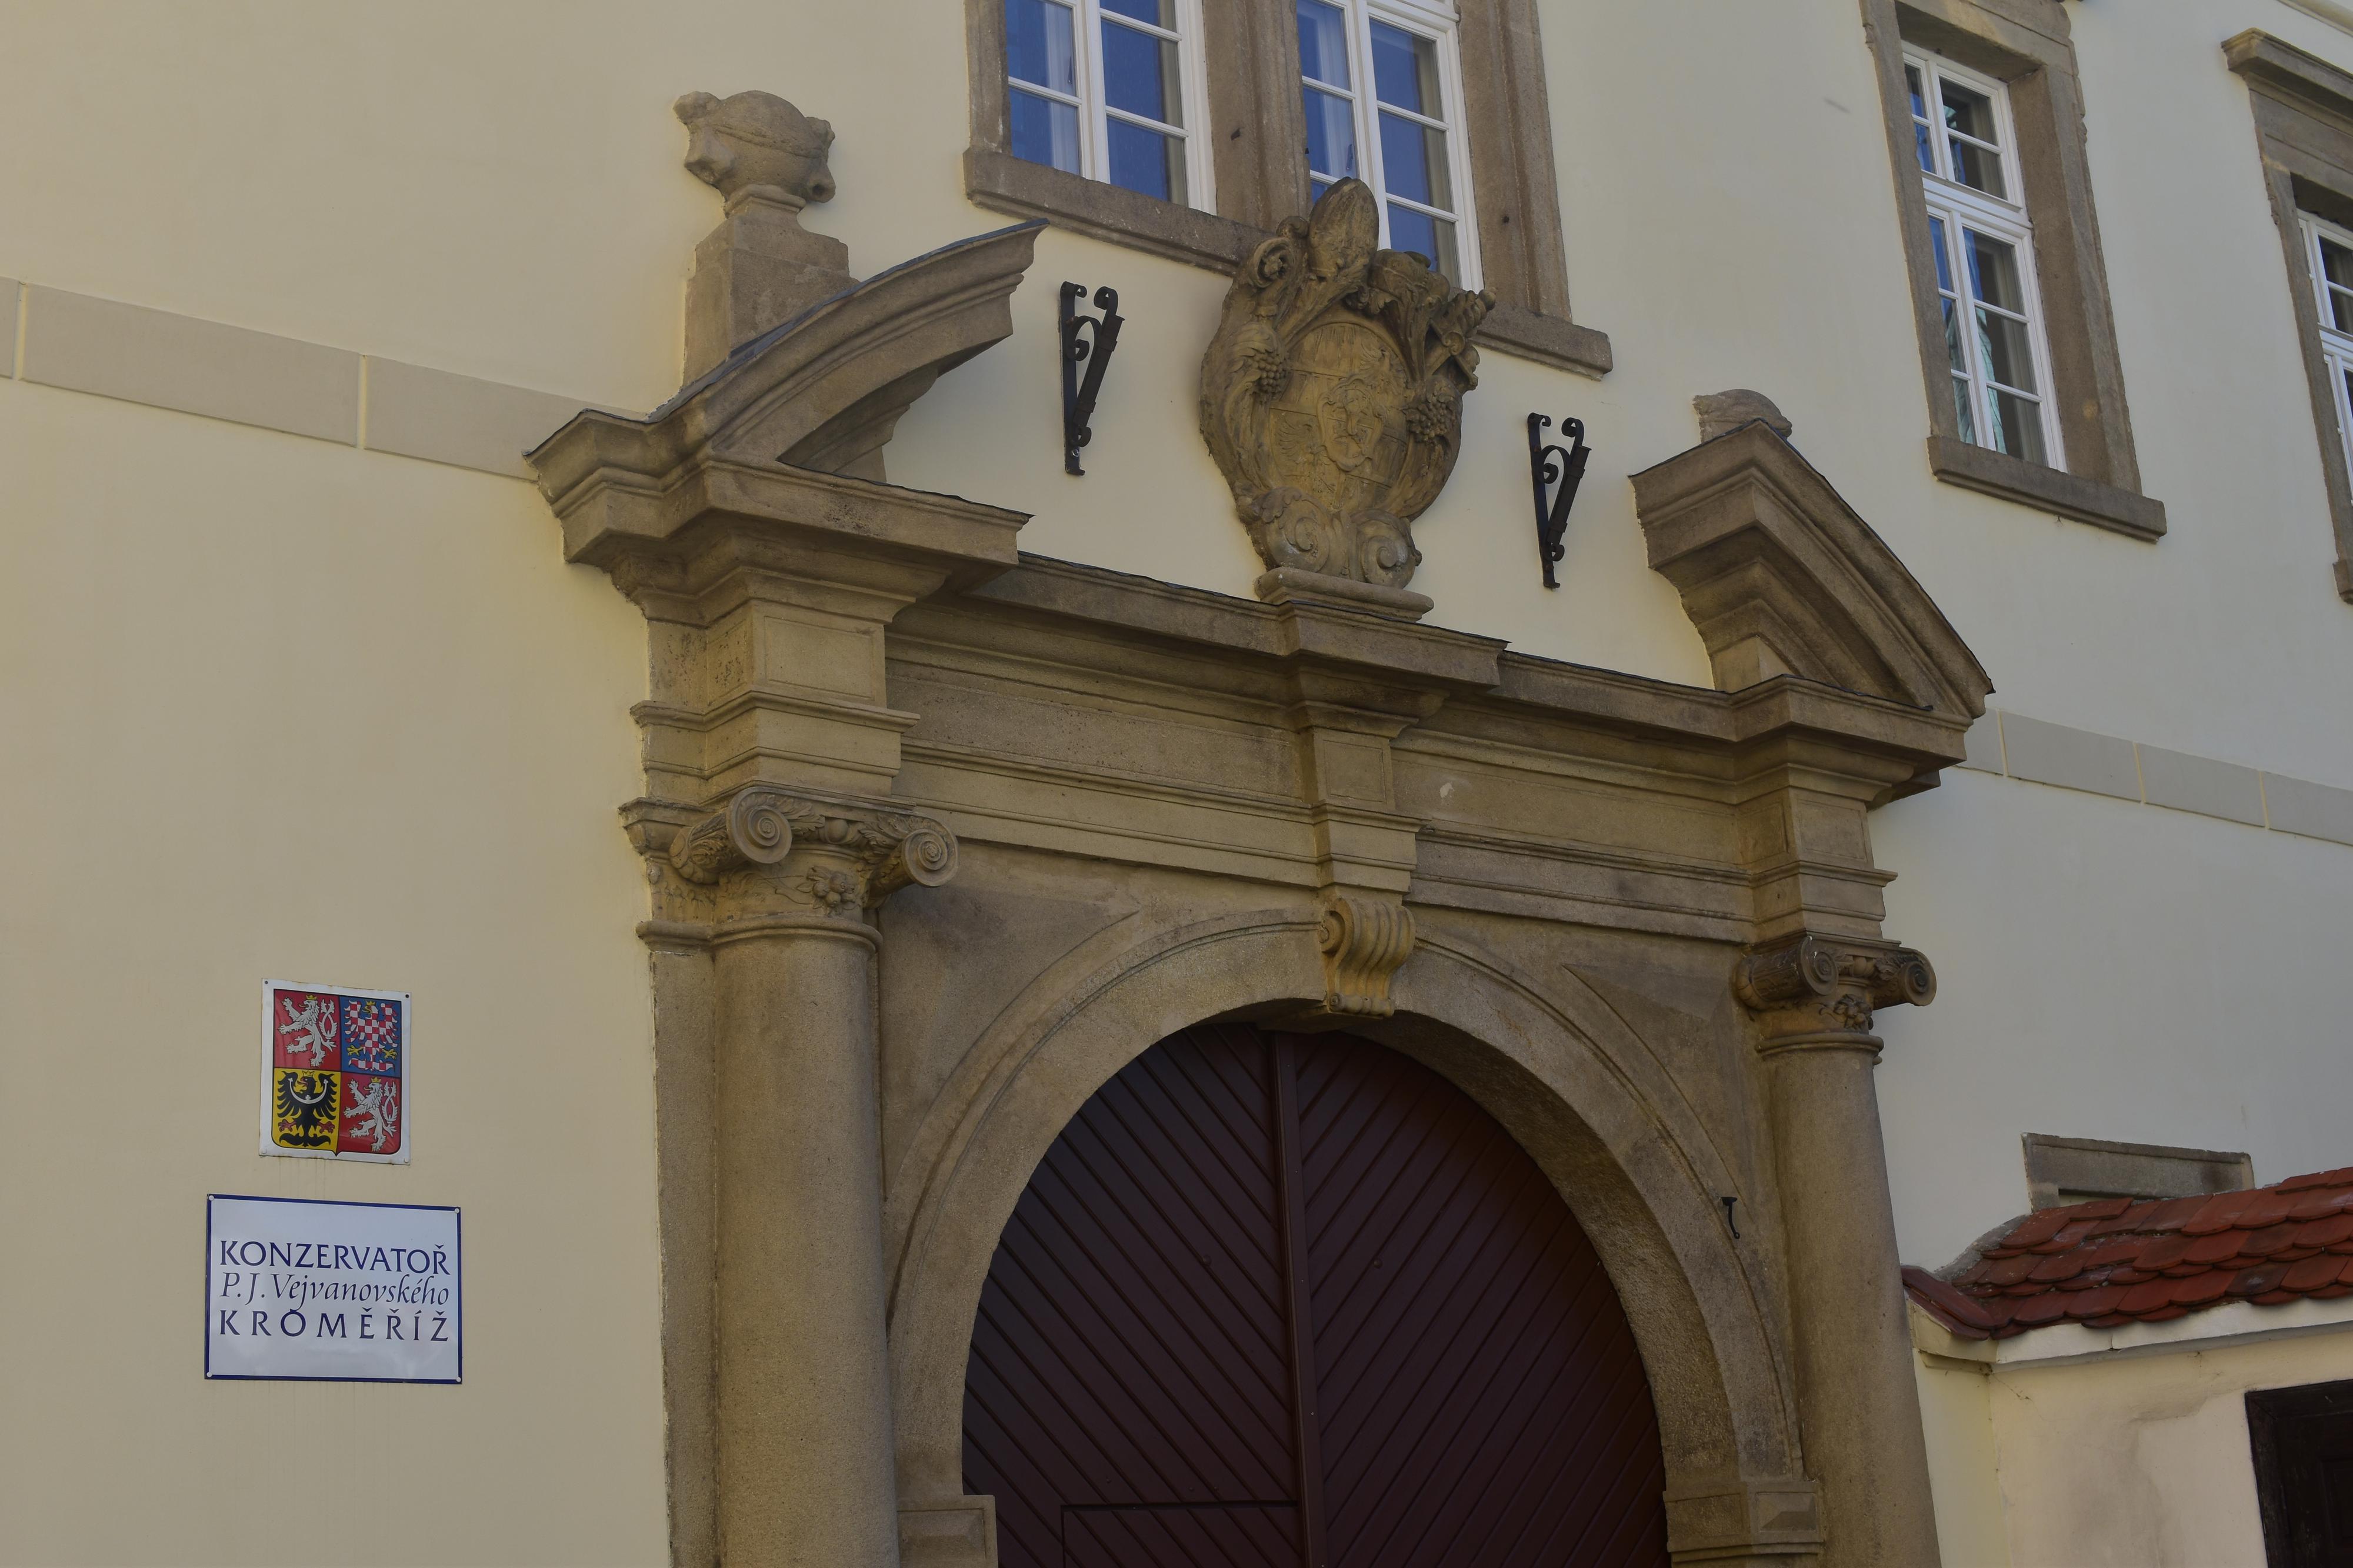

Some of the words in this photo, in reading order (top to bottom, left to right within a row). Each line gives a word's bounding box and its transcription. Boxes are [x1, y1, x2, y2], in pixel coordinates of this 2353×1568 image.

[220, 1240, 451, 1275] KONZERVATOŘ
[270, 1273, 449, 1310] Vejvanovského
[219, 1307, 449, 1342] KROMĚŘÍŽ
